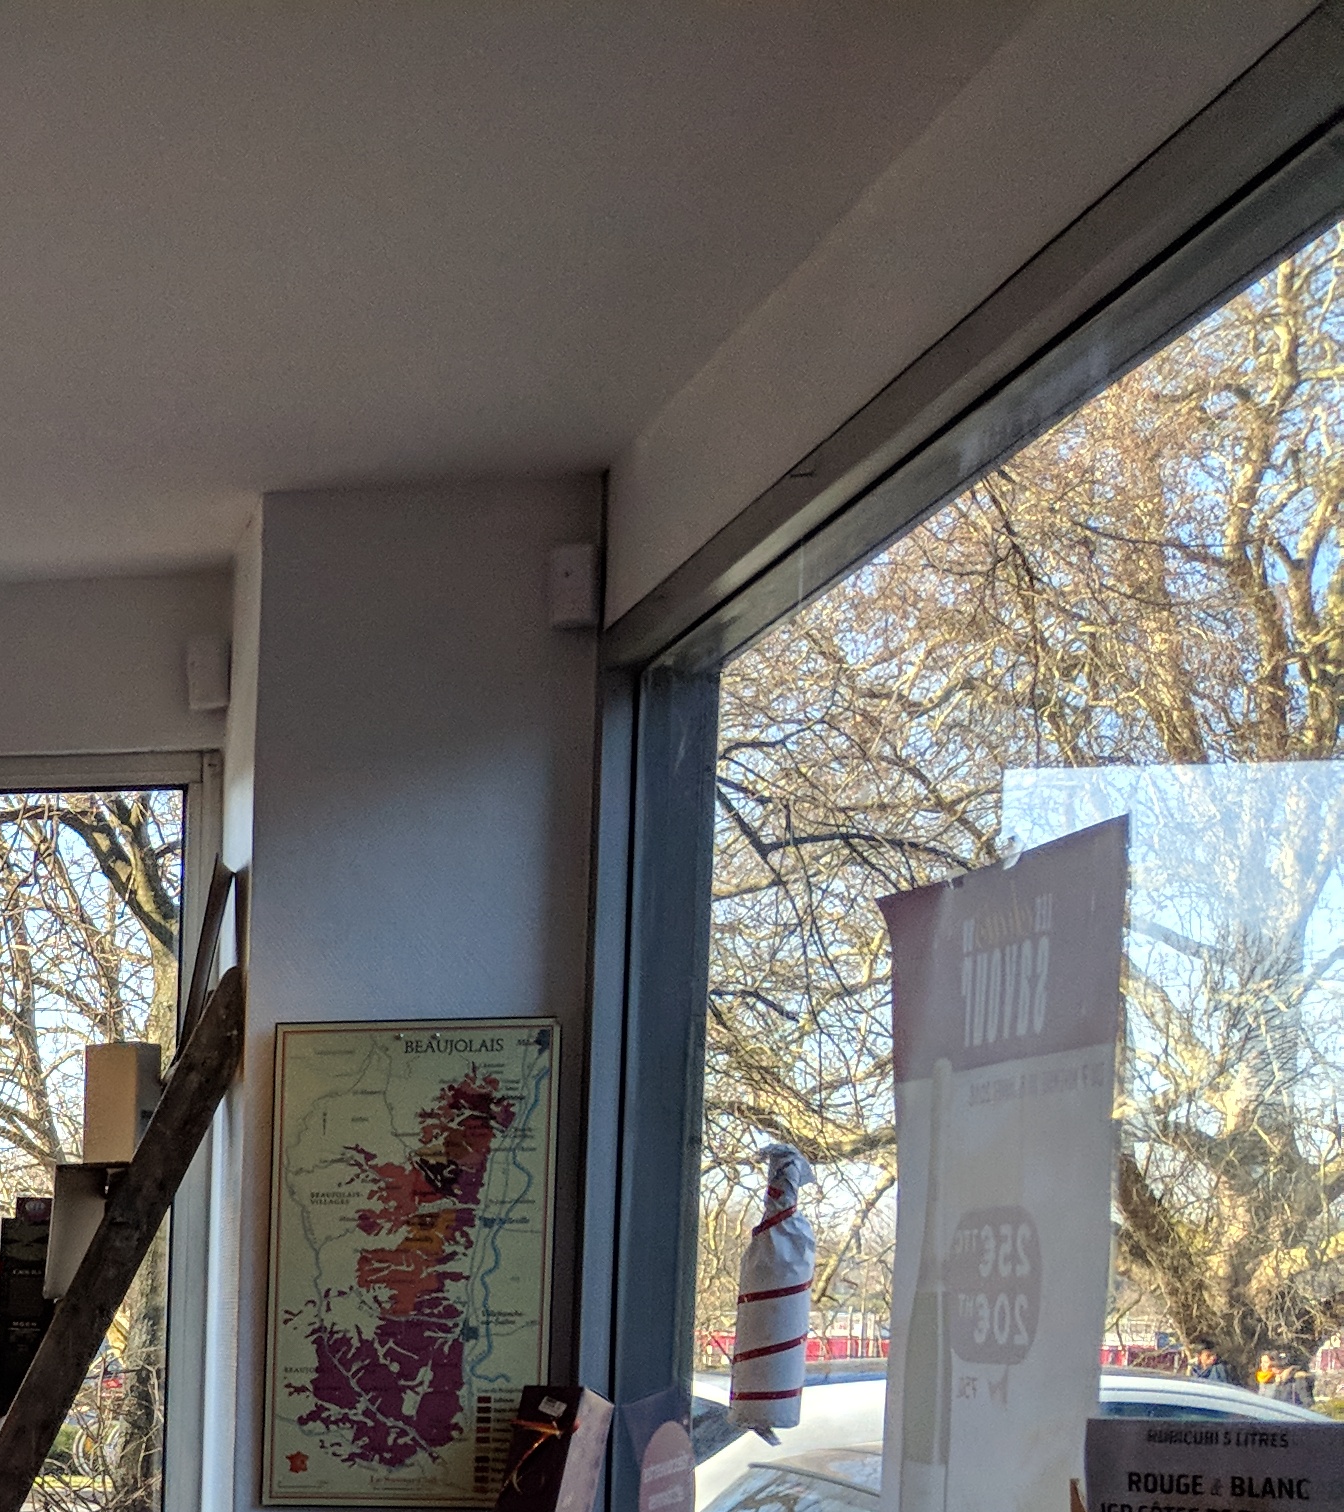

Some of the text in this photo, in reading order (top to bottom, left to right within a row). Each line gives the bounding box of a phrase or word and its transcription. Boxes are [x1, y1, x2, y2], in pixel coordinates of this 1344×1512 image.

[403, 1038, 505, 1055] BEAUJOLAIS
[1234, 1431, 1290, 1448] LITRES
[1127, 1471, 1204, 1496] ROUGE
[1229, 1475, 1311, 1501] BLANC
